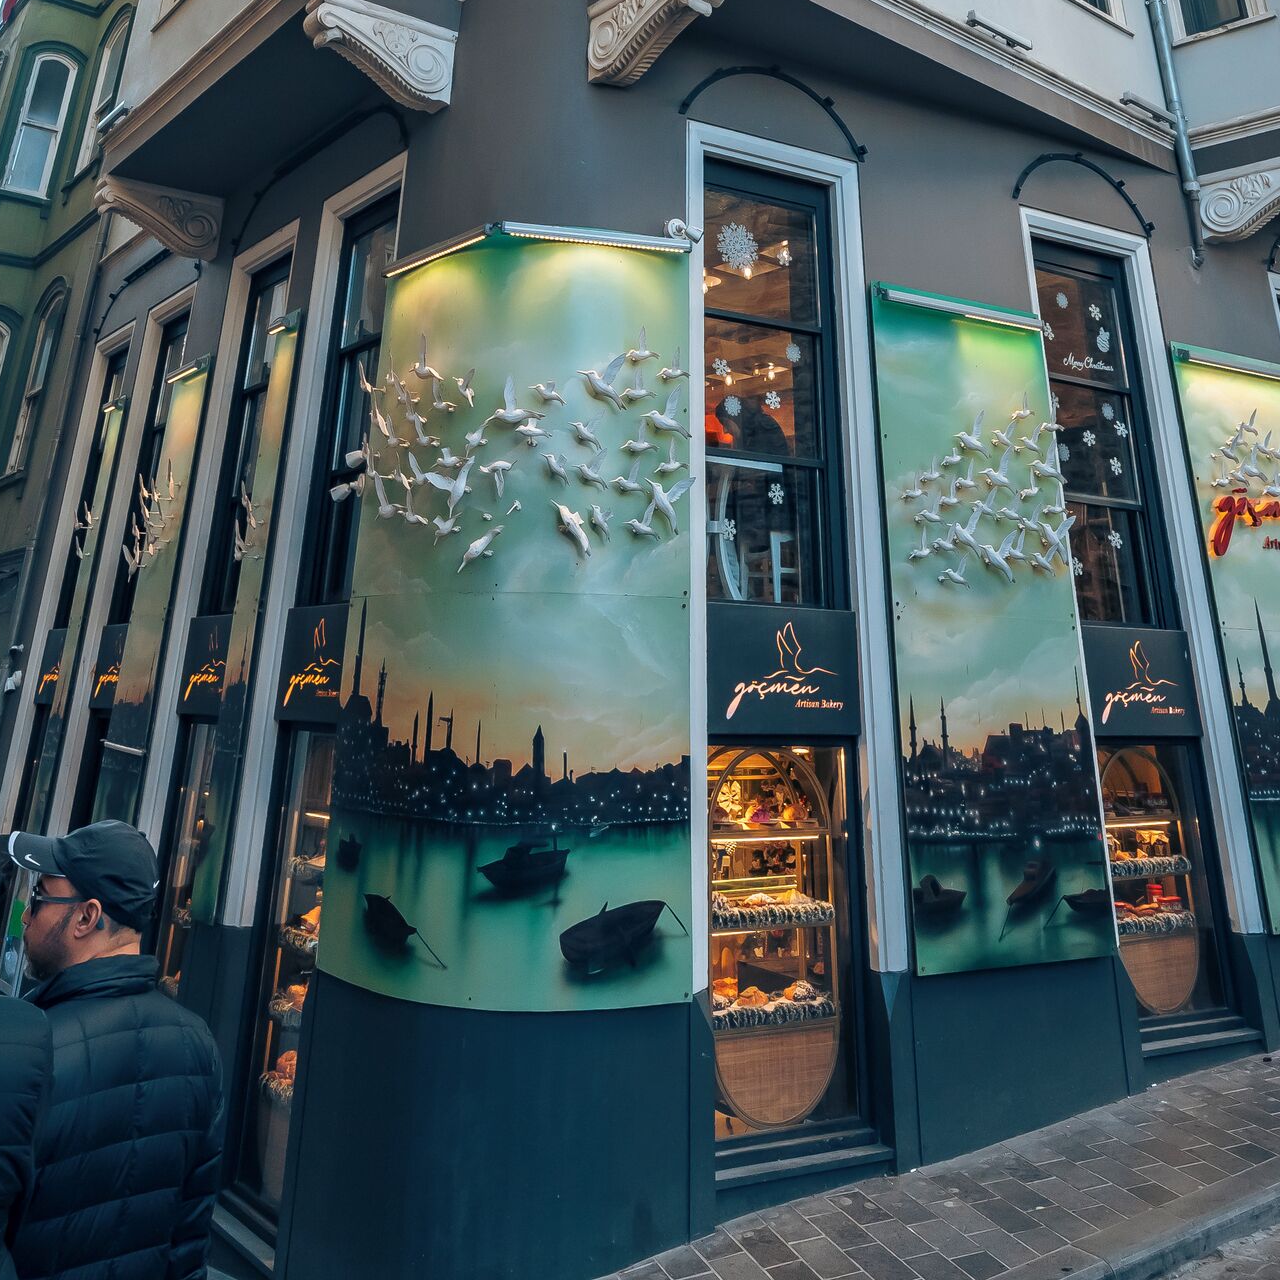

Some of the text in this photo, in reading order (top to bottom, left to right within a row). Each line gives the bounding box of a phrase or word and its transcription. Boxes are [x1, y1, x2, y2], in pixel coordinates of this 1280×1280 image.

[726, 681, 820, 720] göçmen
[820, 699, 844, 711] Bakery
[1102, 691, 1167, 725] göçmen
